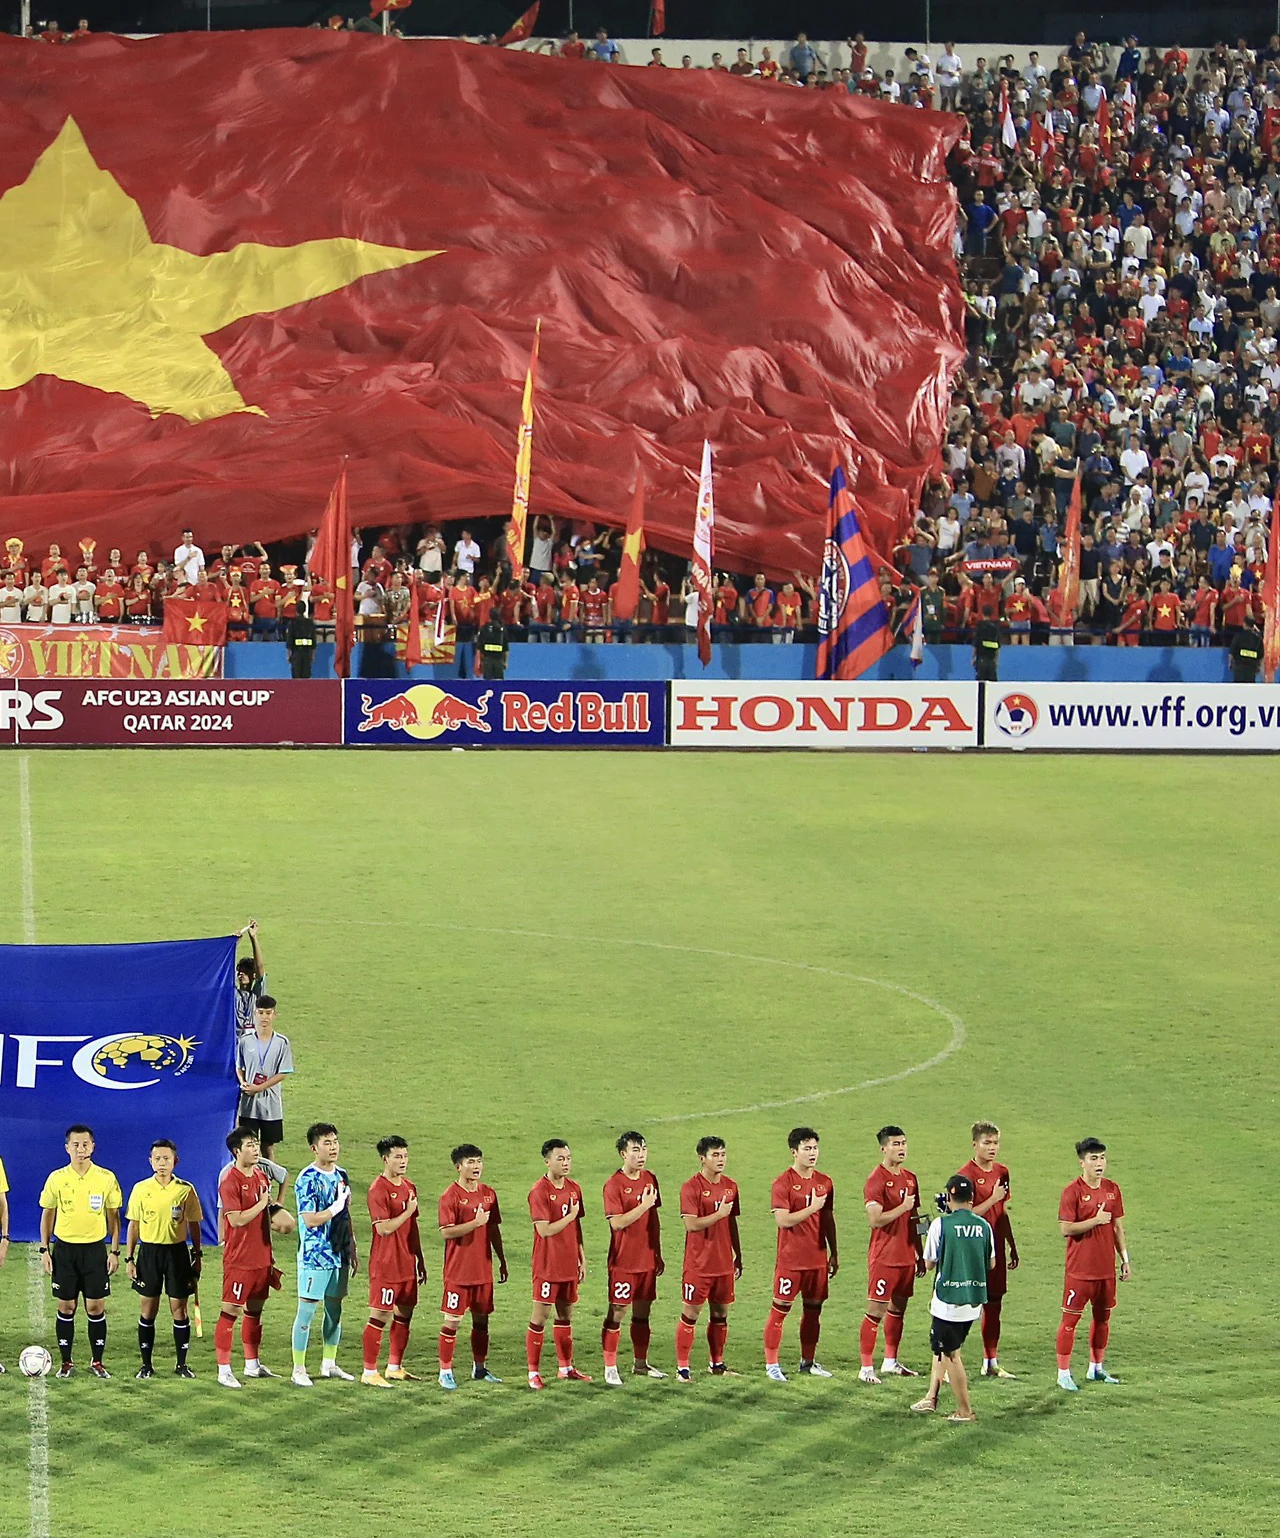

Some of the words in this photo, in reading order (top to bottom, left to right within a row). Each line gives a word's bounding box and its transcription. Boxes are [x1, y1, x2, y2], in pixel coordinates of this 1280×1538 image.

[965, 560, 1012, 570] VIETNAM
[81, 690, 124, 706] AFC
[125, 690, 162, 706] U23
[164, 690, 227, 706] ASIAN
[501, 691, 574, 733] Red
[576, 691, 651, 733] Bull
[676, 695, 973, 732] HONDA
[1049, 696, 1280, 735] www.vff.org.v
[123, 714, 185, 733] QATAR
[190, 714, 233, 731] 2024
[953, 1225, 984, 1238] TV/R
[232, 1281, 243, 1300] 4
[306, 1277, 314, 1293] 1
[540, 1281, 551, 1298] 8
[614, 1282, 631, 1299] 22
[684, 1282, 695, 1301] 17
[778, 1277, 792, 1295] 12
[381, 1287, 394, 1305] 10
[446, 1290, 460, 1309] 18
